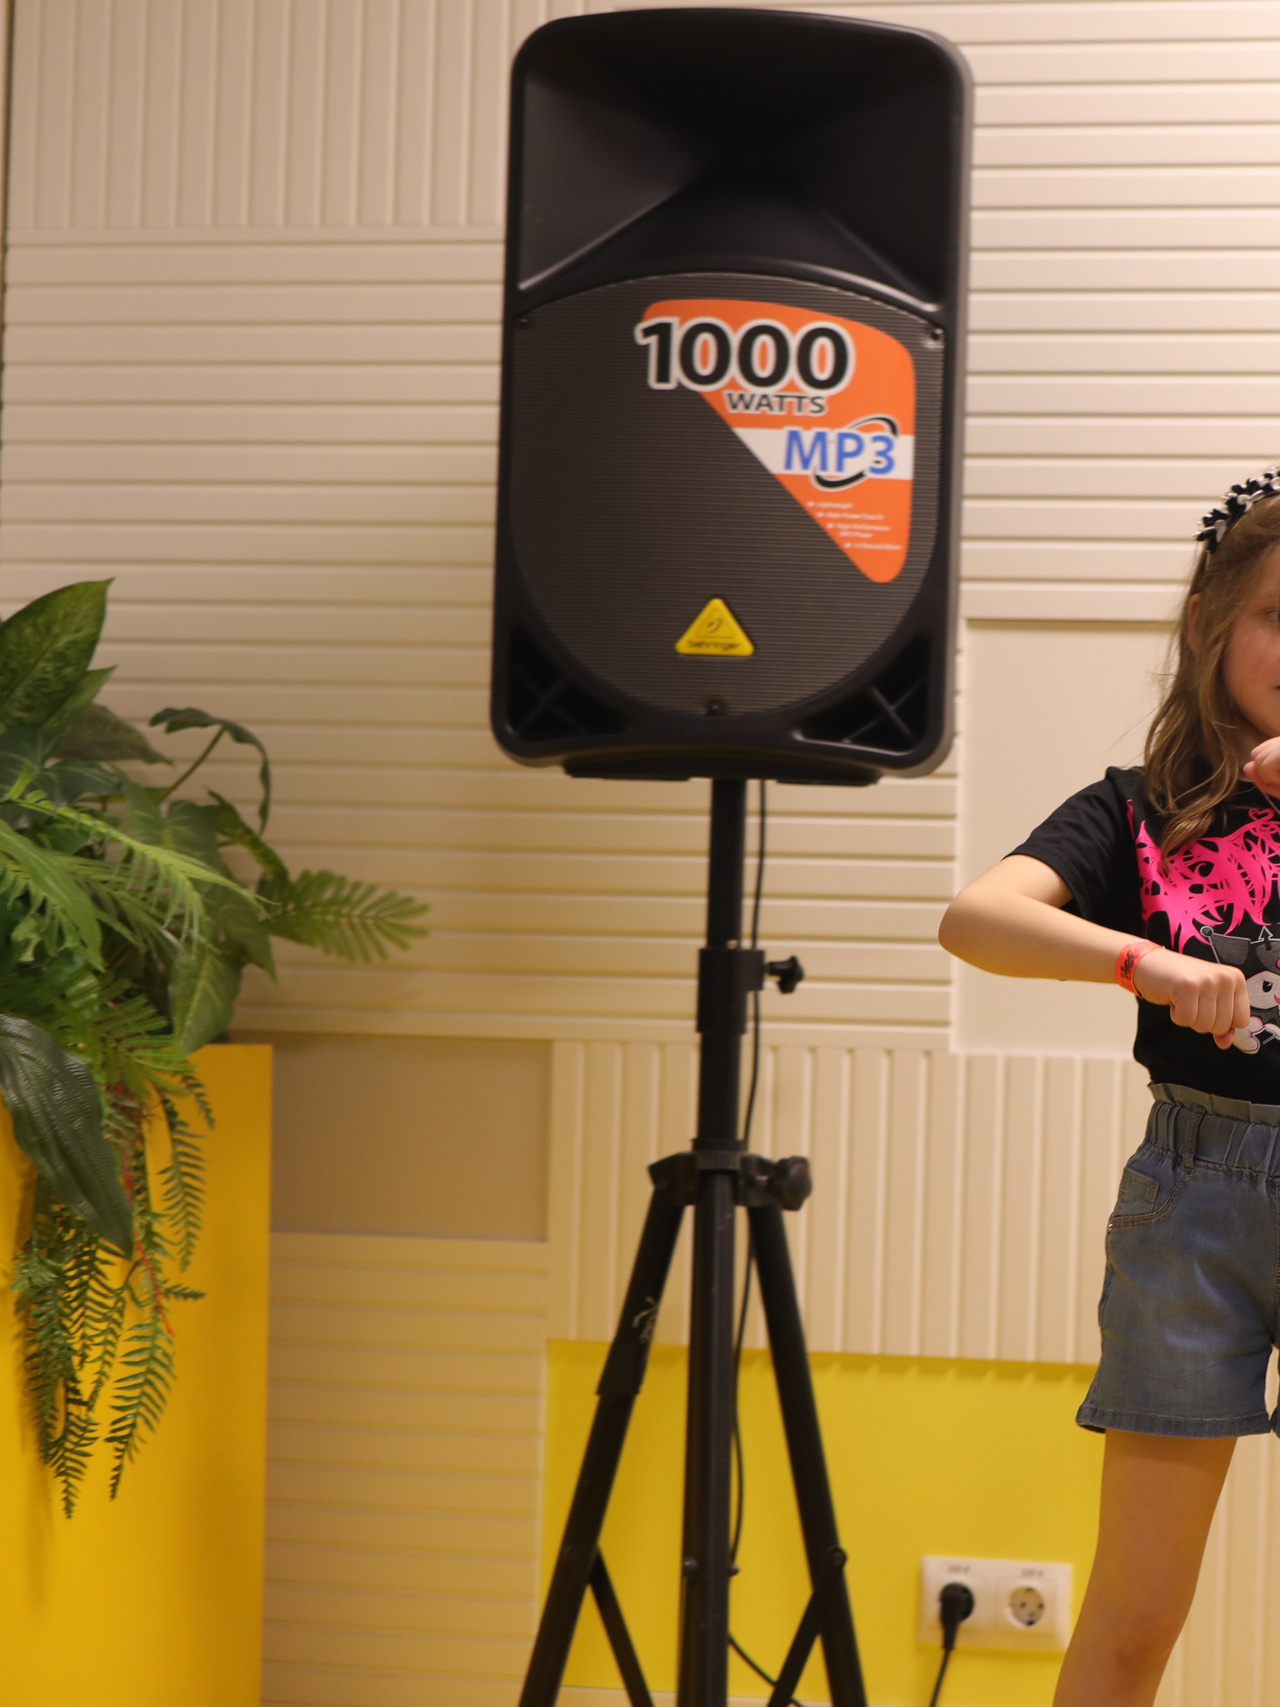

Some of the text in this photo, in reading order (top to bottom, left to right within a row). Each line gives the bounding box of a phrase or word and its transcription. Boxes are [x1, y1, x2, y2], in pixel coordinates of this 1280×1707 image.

[637, 317, 854, 396] 1000
[726, 392, 828, 415] WATTS
[783, 428, 896, 475] MP3
